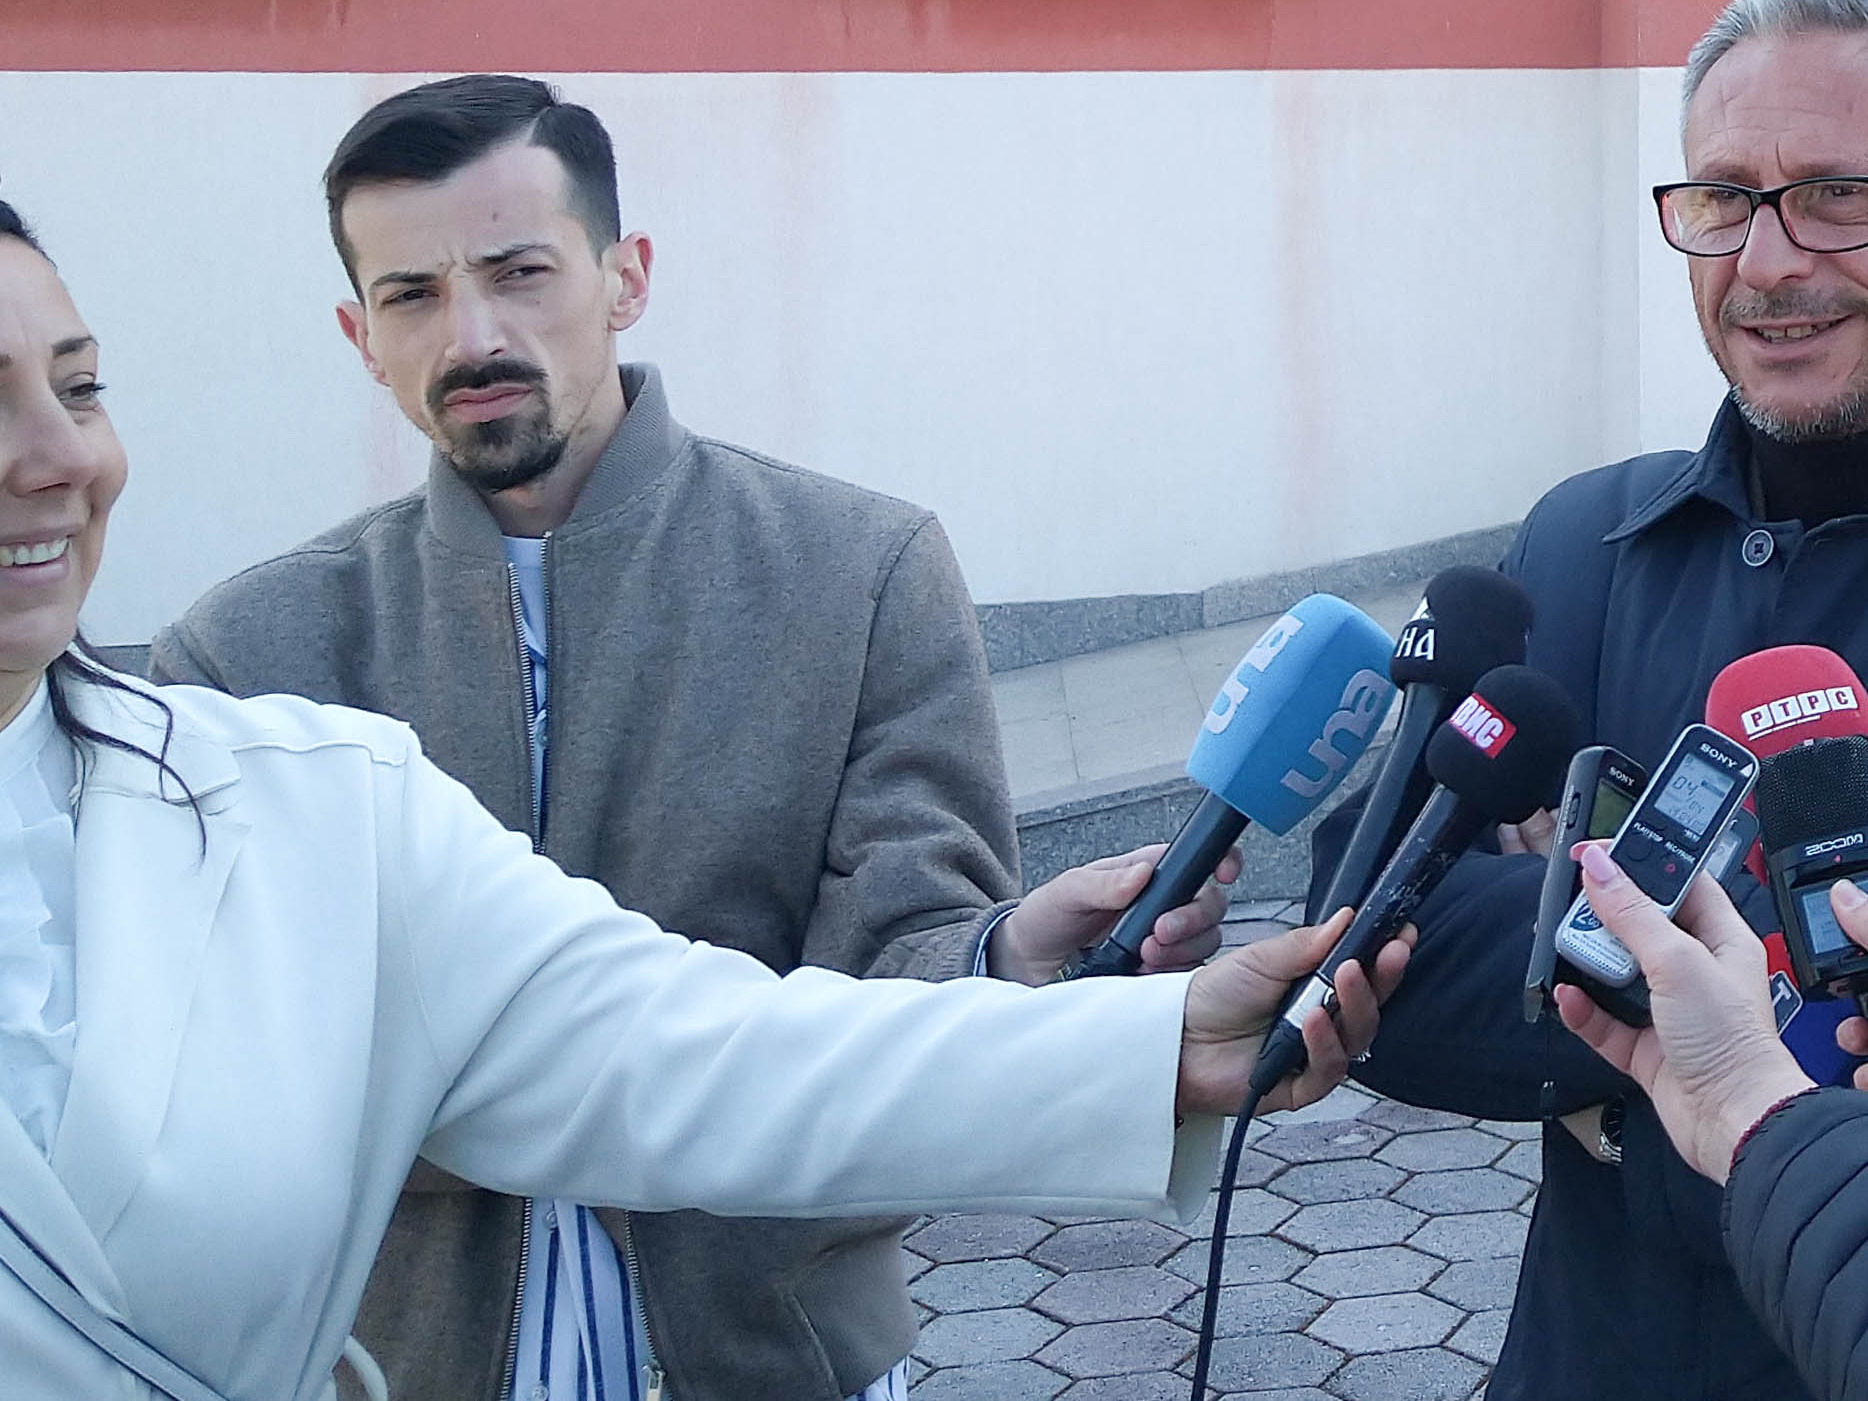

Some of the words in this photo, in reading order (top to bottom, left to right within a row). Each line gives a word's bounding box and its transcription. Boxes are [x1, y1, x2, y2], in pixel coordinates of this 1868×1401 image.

[1746, 688, 1854, 731] РТРС
[1281, 669, 1393, 798] una
[1700, 743, 1738, 768] SONY
[1609, 766, 1635, 786] SONY
[1805, 833, 1864, 856] ZOOM
